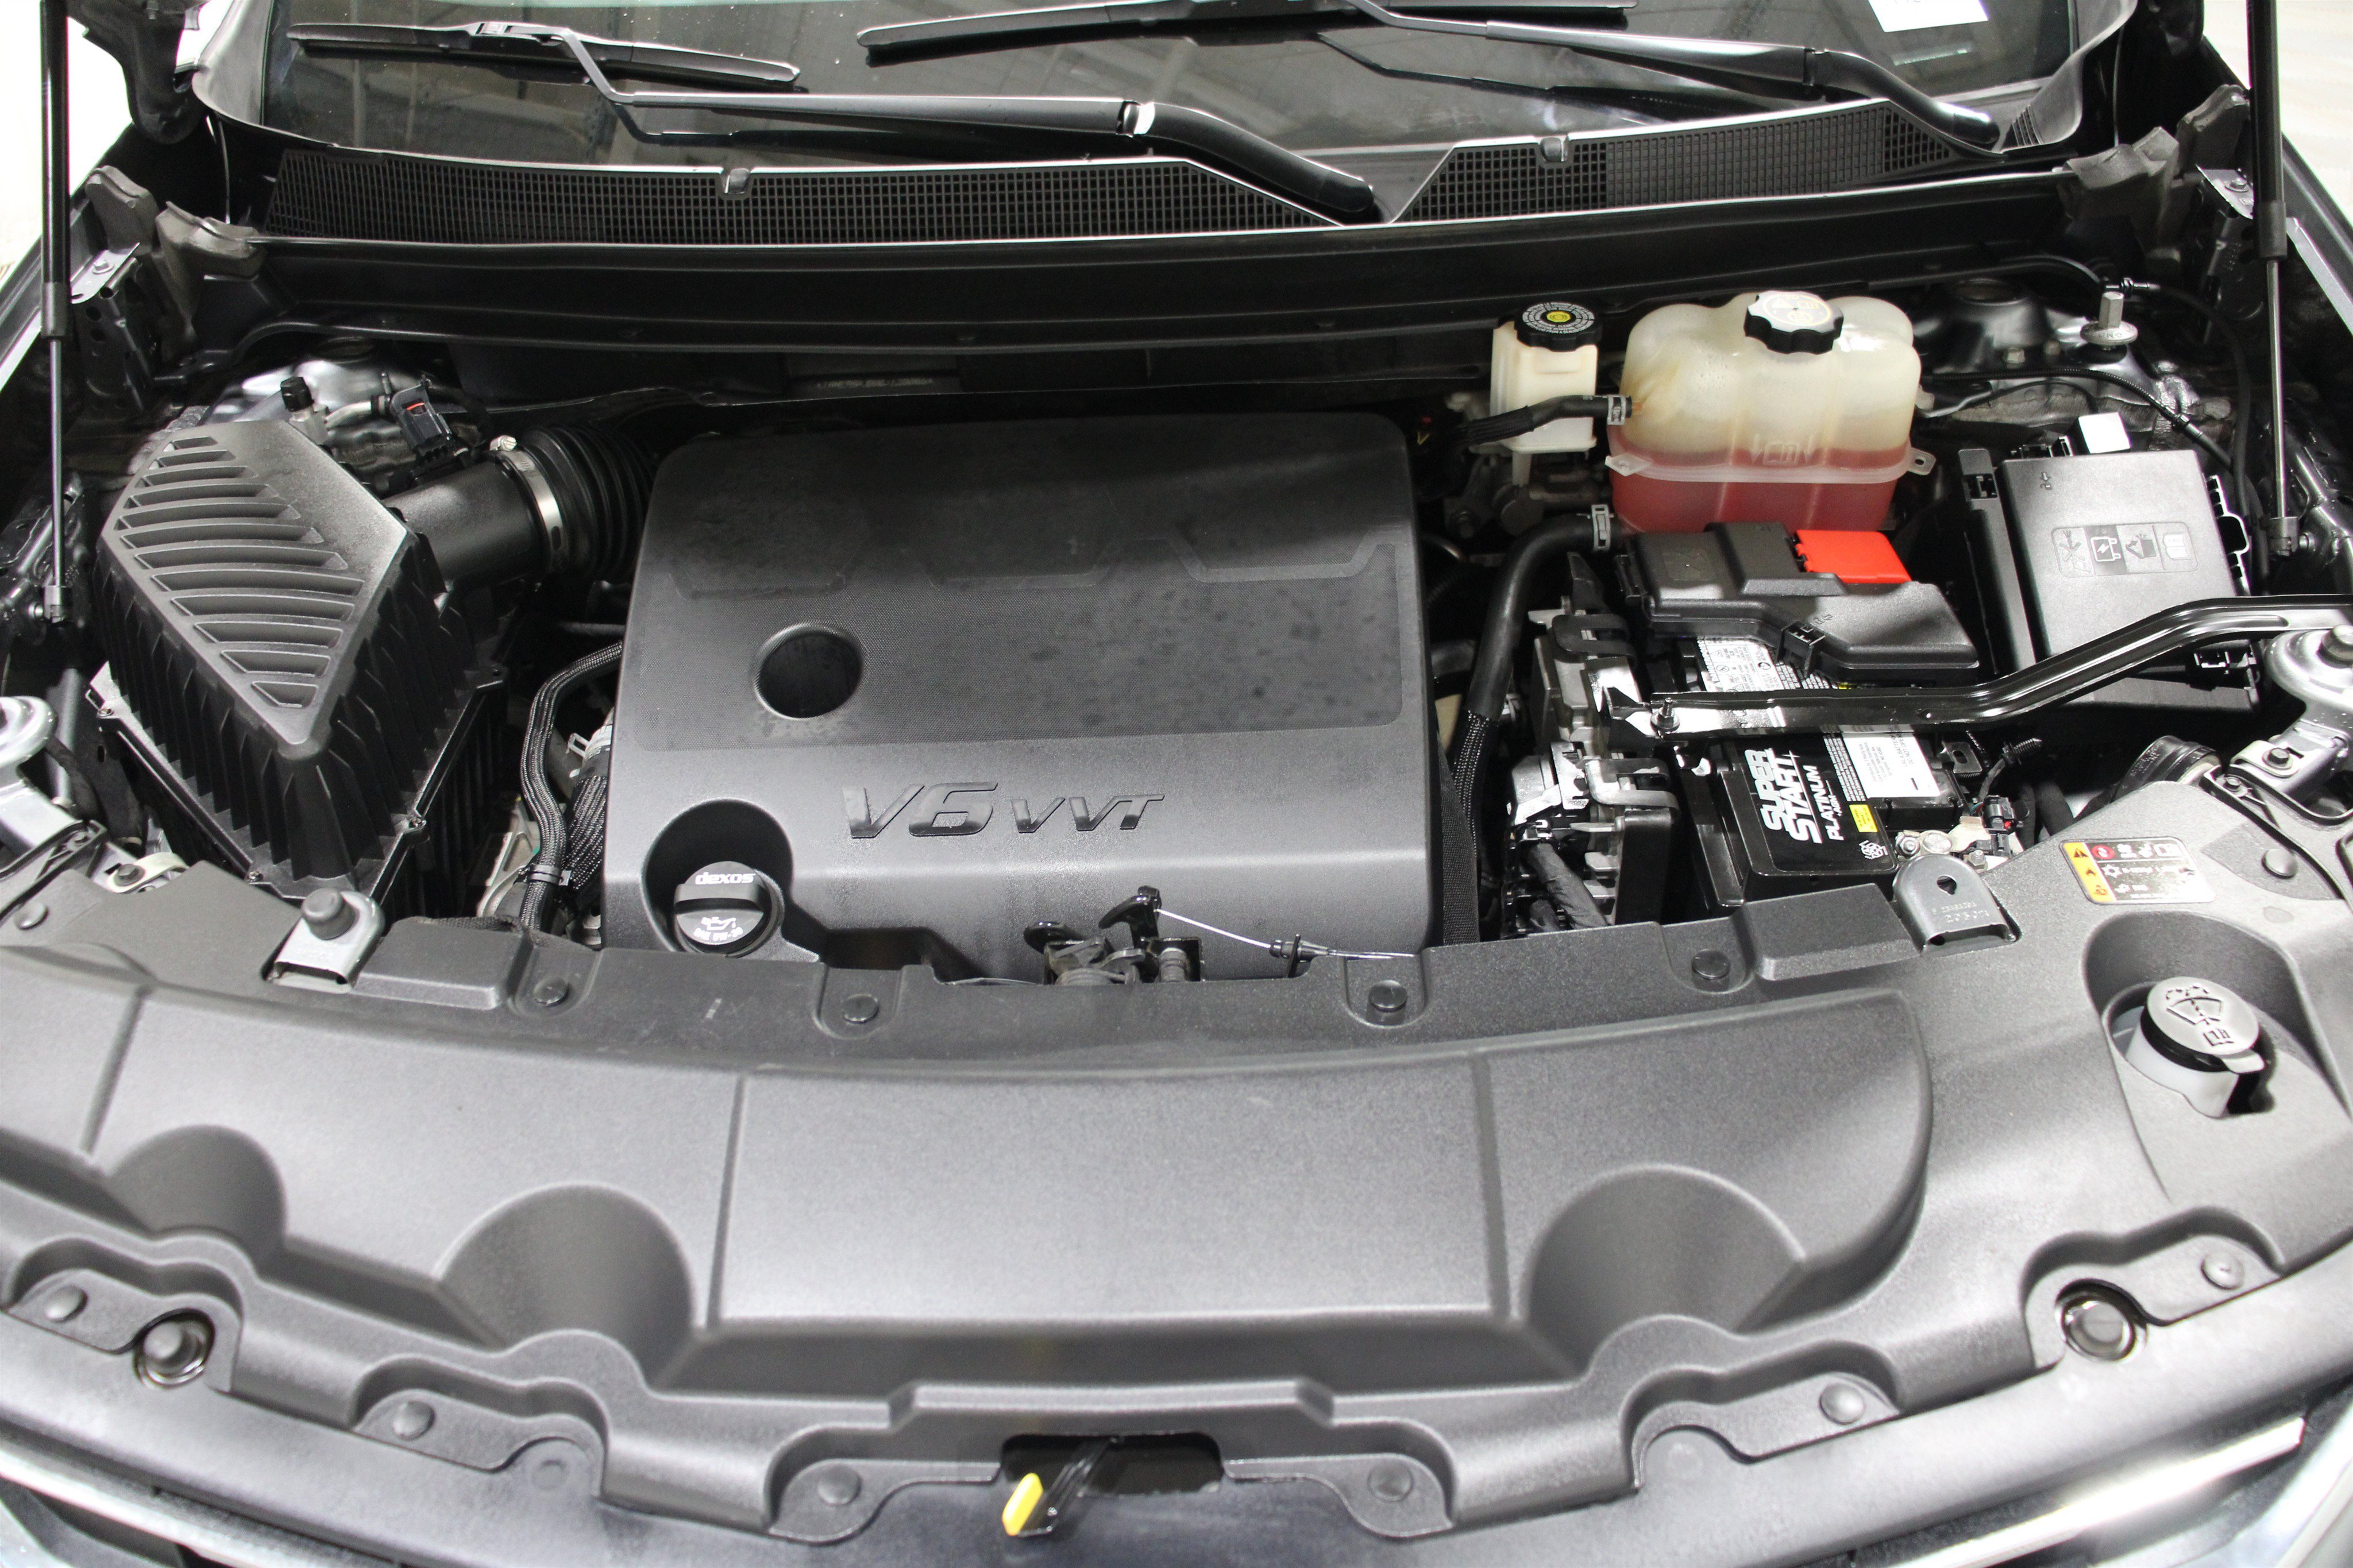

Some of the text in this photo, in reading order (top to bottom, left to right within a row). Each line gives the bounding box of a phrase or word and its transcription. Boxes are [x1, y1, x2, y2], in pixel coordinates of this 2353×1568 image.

[842, 782, 1165, 839] V6 VVT
[1744, 750, 1788, 831] SUPER
[1764, 748, 1822, 843] START
[1803, 765, 1844, 840] PLATINUM
[695, 872, 756, 885] dexos
